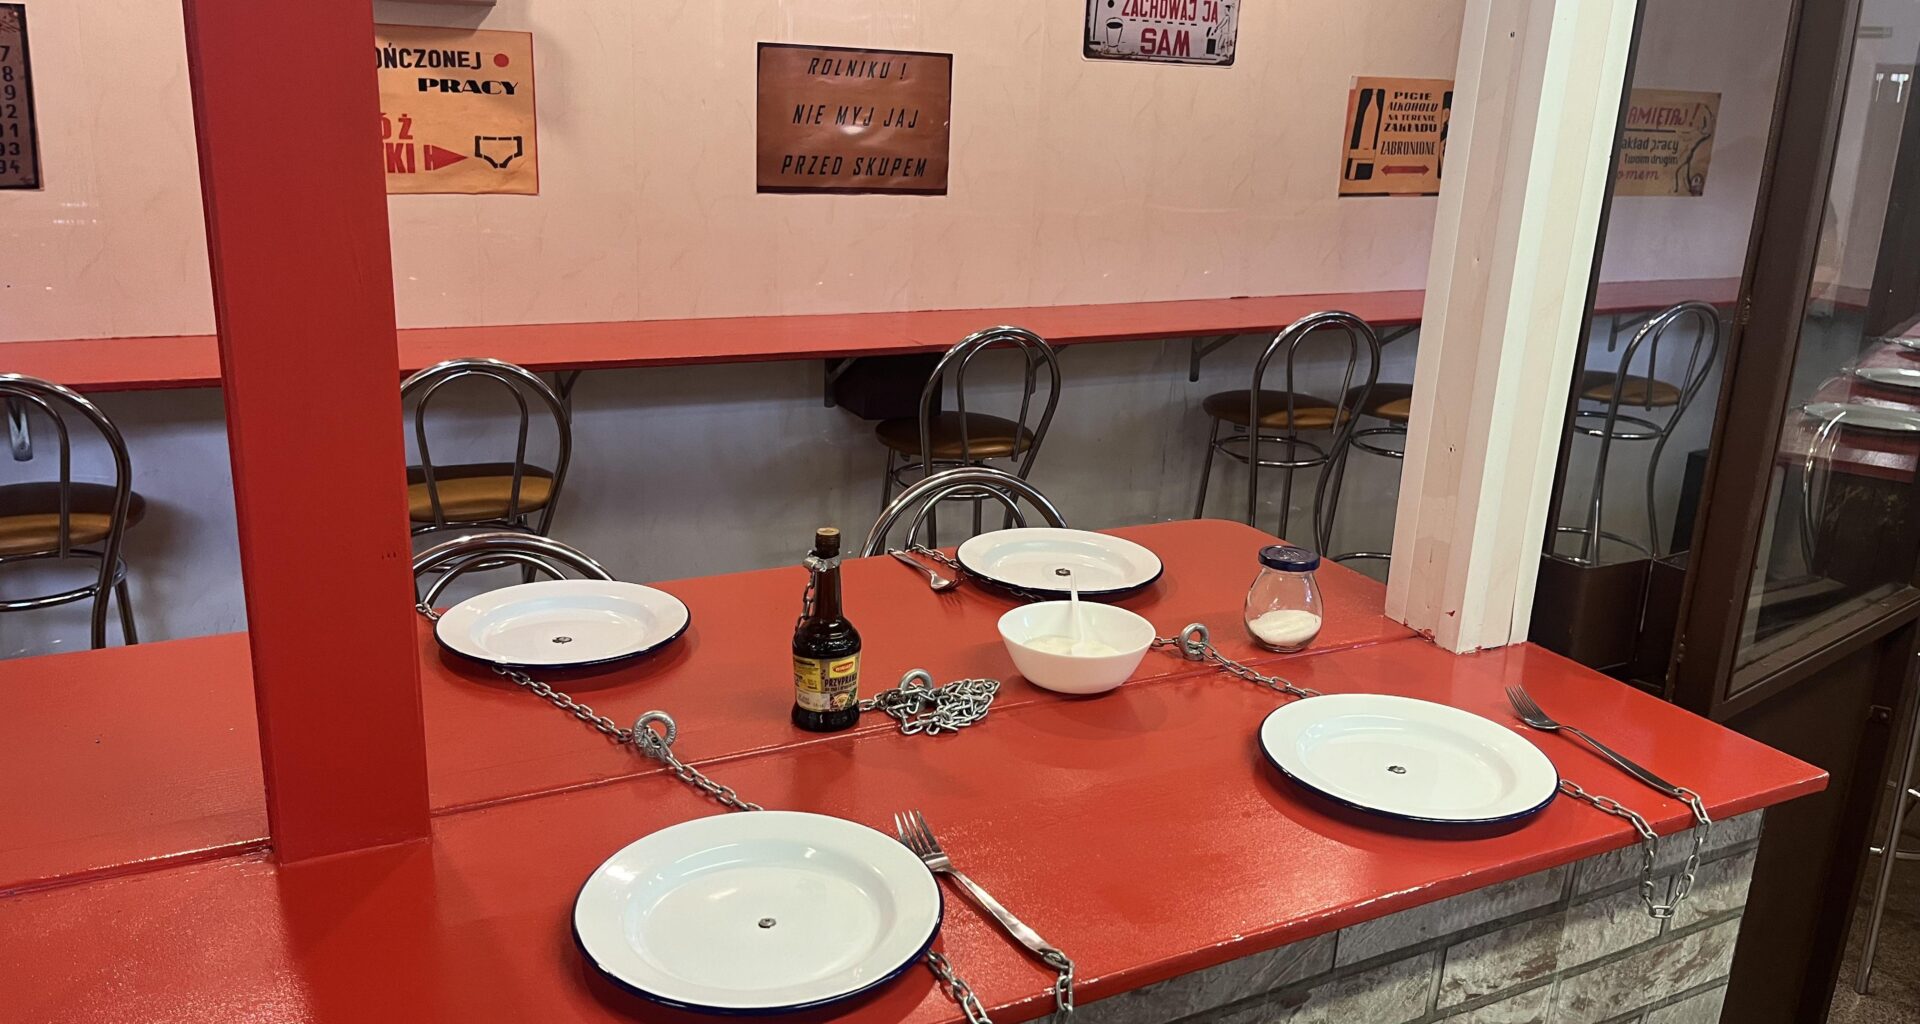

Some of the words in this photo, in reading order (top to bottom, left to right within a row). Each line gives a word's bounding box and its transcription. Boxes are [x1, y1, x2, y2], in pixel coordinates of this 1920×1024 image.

[1122, 0, 1198, 21] ZACHOWAJ
[1140, 28, 1190, 57] SAM
[2, 65, 14, 82] 8
[808, 57, 891, 79] ROLNIKU
[4, 84, 16, 100] 9
[418, 78, 519, 95] PRACY
[0, 104, 18, 119] 2
[1389, 101, 1439, 112] ALKOHOLU
[792, 104, 826, 125] NIE
[835, 105, 875, 126] MYJ
[883, 108, 919, 128] JAJ
[1401, 114, 1436, 122] TERENIE
[1384, 122, 1437, 133] ZAKŁADU
[1380, 141, 1436, 156] ZABRONIONE
[781, 155, 844, 176] PRZED
[853, 156, 928, 177] SKUPEM
